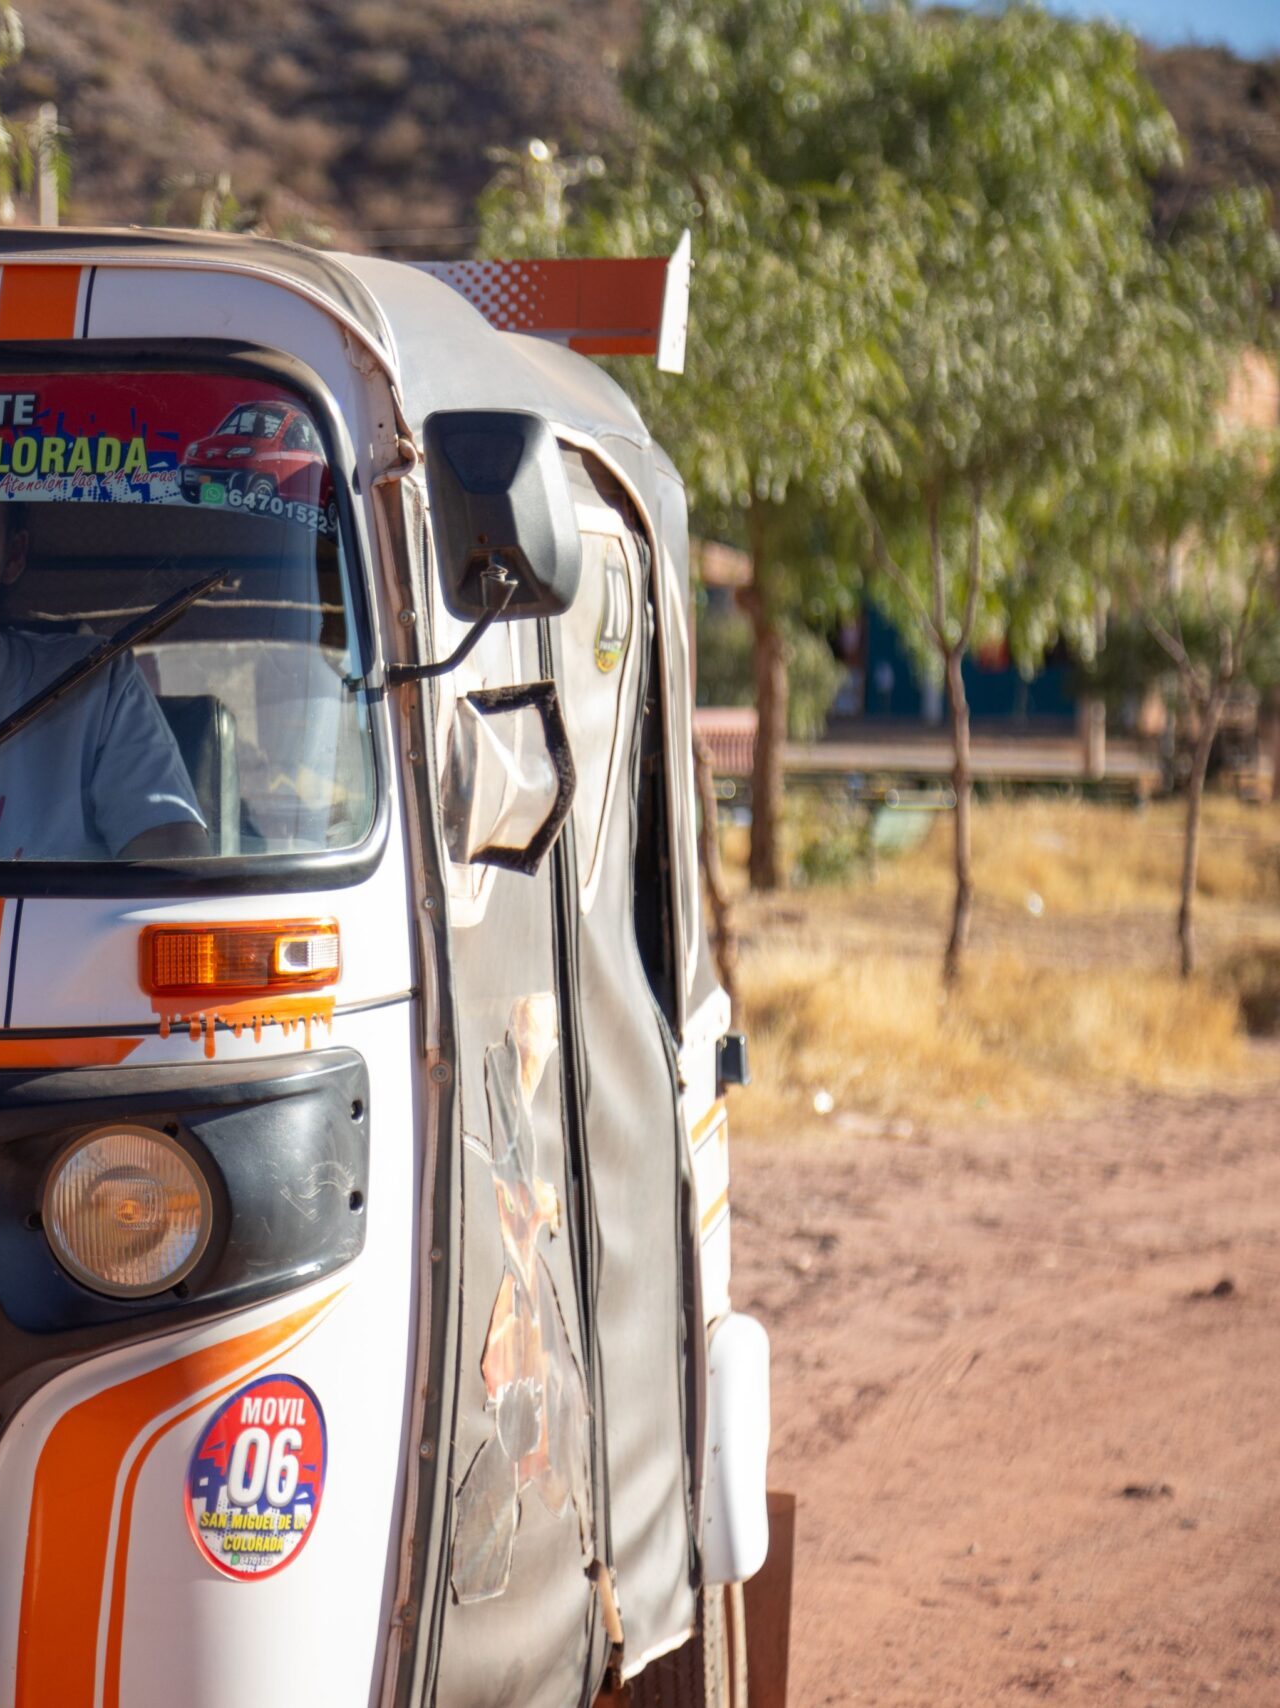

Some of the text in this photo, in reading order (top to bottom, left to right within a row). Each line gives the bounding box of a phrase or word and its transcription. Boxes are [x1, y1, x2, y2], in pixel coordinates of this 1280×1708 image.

[71, 466, 97, 488] las
[101, 468, 125, 486] 24
[131, 465, 177, 484] horas
[228, 488, 328, 534] 64701522
[240, 1396, 306, 1426] MOVIL
[227, 1427, 303, 1508] 06
[200, 1511, 227, 1528] SAN
[231, 1513, 274, 1530] MIGUEL
[278, 1513, 292, 1529] DE
[222, 1535, 284, 1552] COLORADA
